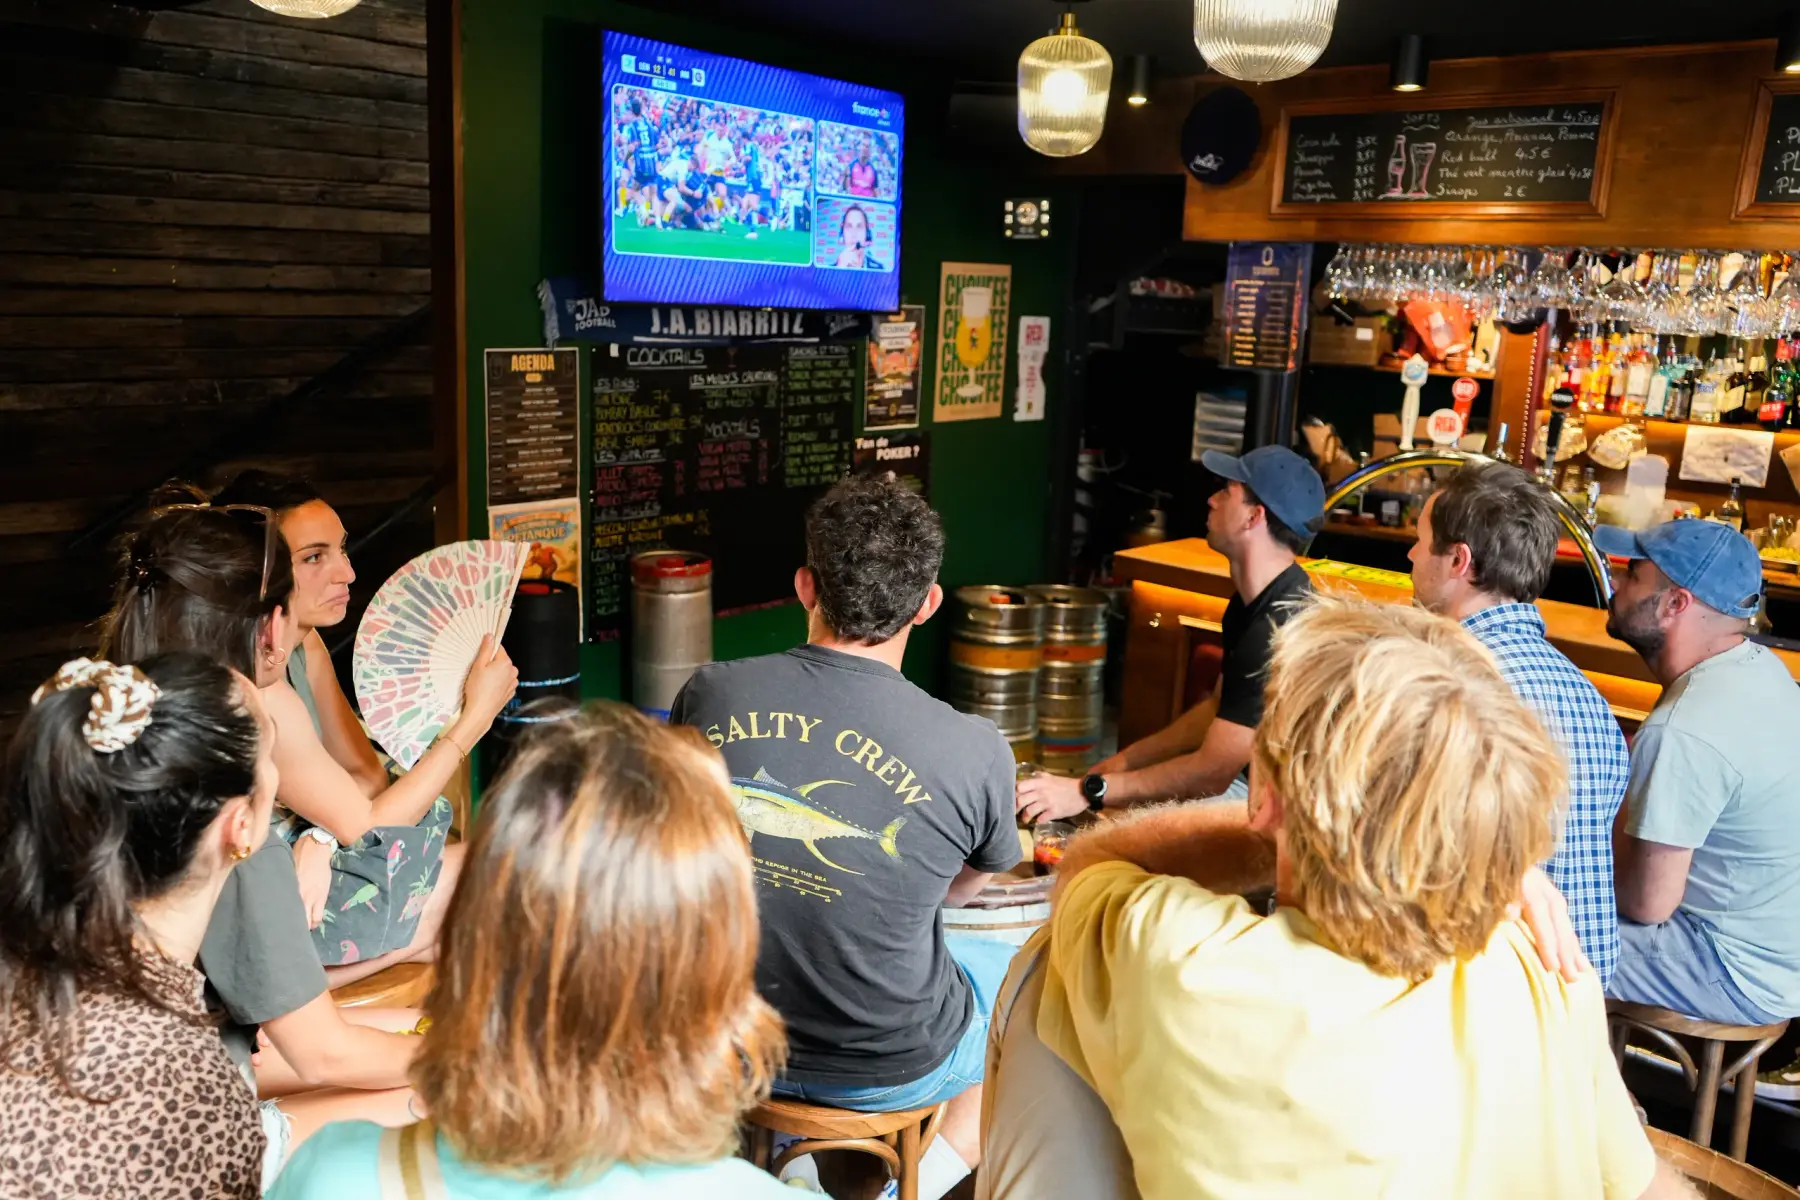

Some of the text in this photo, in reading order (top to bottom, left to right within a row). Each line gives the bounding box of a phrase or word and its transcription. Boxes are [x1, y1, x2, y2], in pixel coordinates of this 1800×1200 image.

[1441, 150, 1464, 163] Red
[511, 353, 555, 372] AGENDA
[627, 347, 705, 366] COCKTAILS
[876, 446, 912, 461] POKER
[705, 711, 932, 805] SALTY CREW
